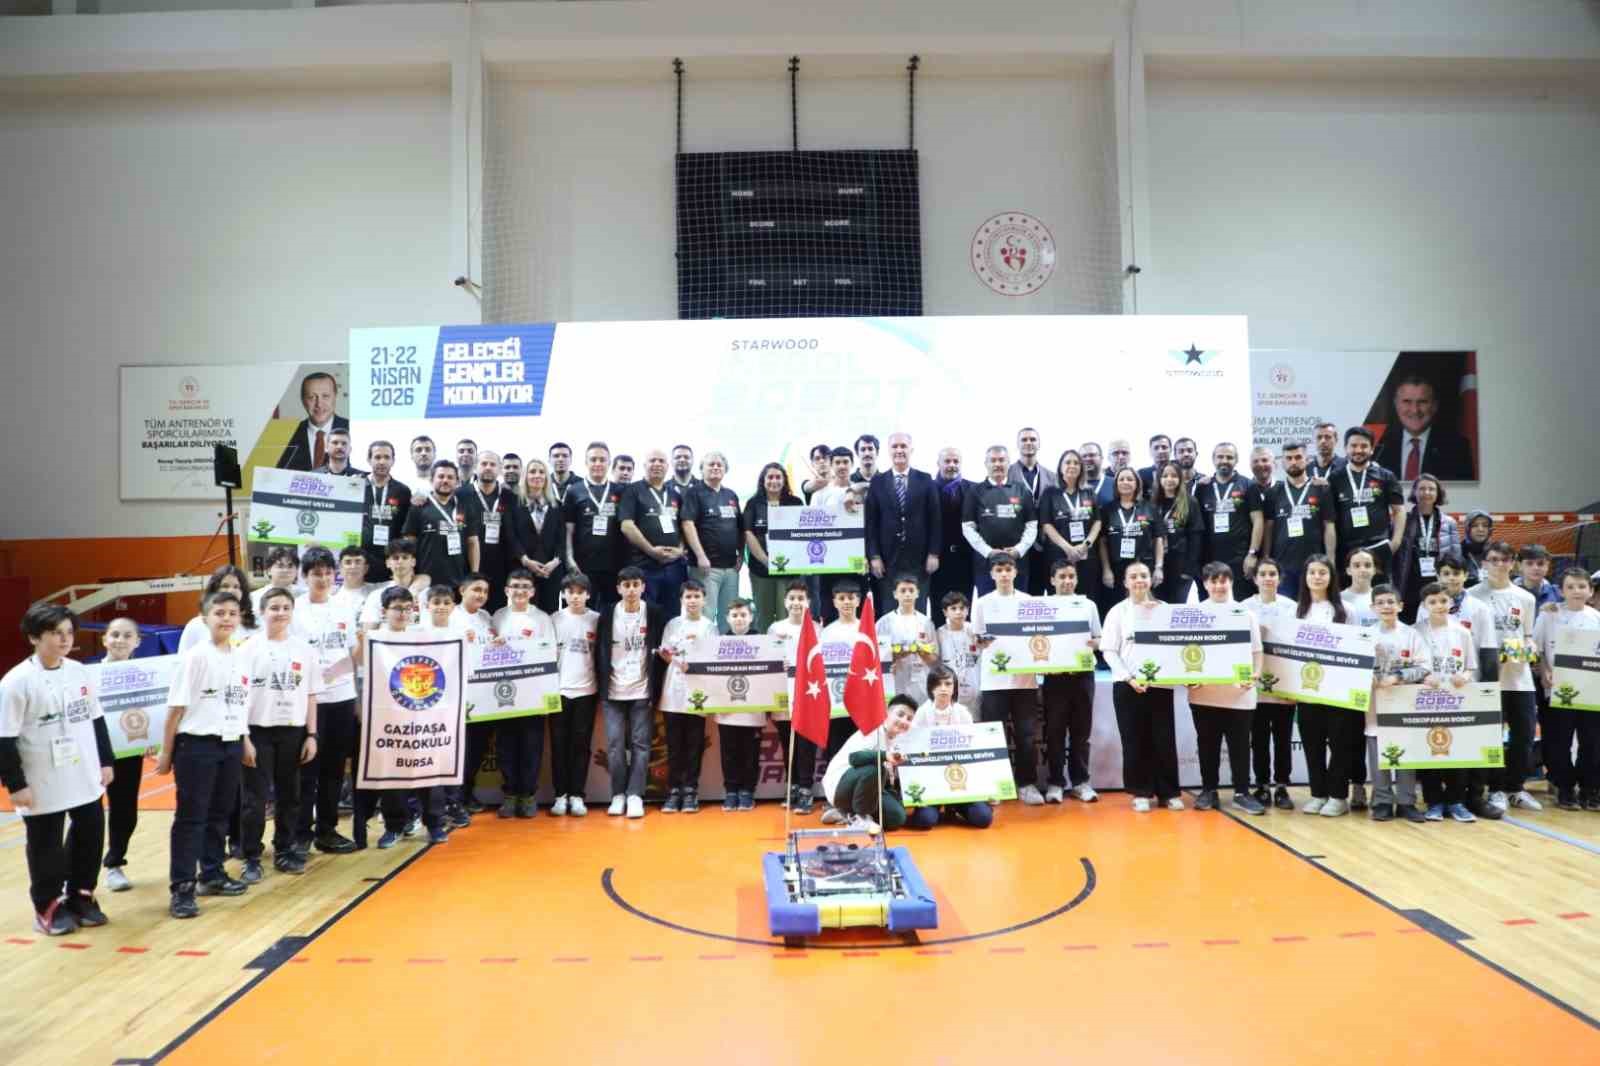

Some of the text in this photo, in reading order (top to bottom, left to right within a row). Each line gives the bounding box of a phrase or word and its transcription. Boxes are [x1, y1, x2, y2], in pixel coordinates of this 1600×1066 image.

[731, 338, 819, 351] STARWOOD
[443, 361, 525, 385] GENÇLER
[370, 387, 415, 407] 2026
[443, 384, 533, 406] KODLUYOR
[144, 417, 234, 428] TÜM ANTRENÖR VE
[146, 429, 232, 439] SPORCULARIMIZA
[141, 440, 188, 450] BAŞARILAR
[1170, 615, 1216, 624] ROBOT
[717, 646, 760, 656] ROBOT
[748, 664, 769, 672] ROBOT
[1415, 696, 1464, 705] ROBOT
[1450, 715, 1475, 723] ROBOT
[384, 721, 447, 737] GAZİPAŞA
[376, 736, 452, 750] ORTAOKULU
[396, 757, 434, 768] BURSA
